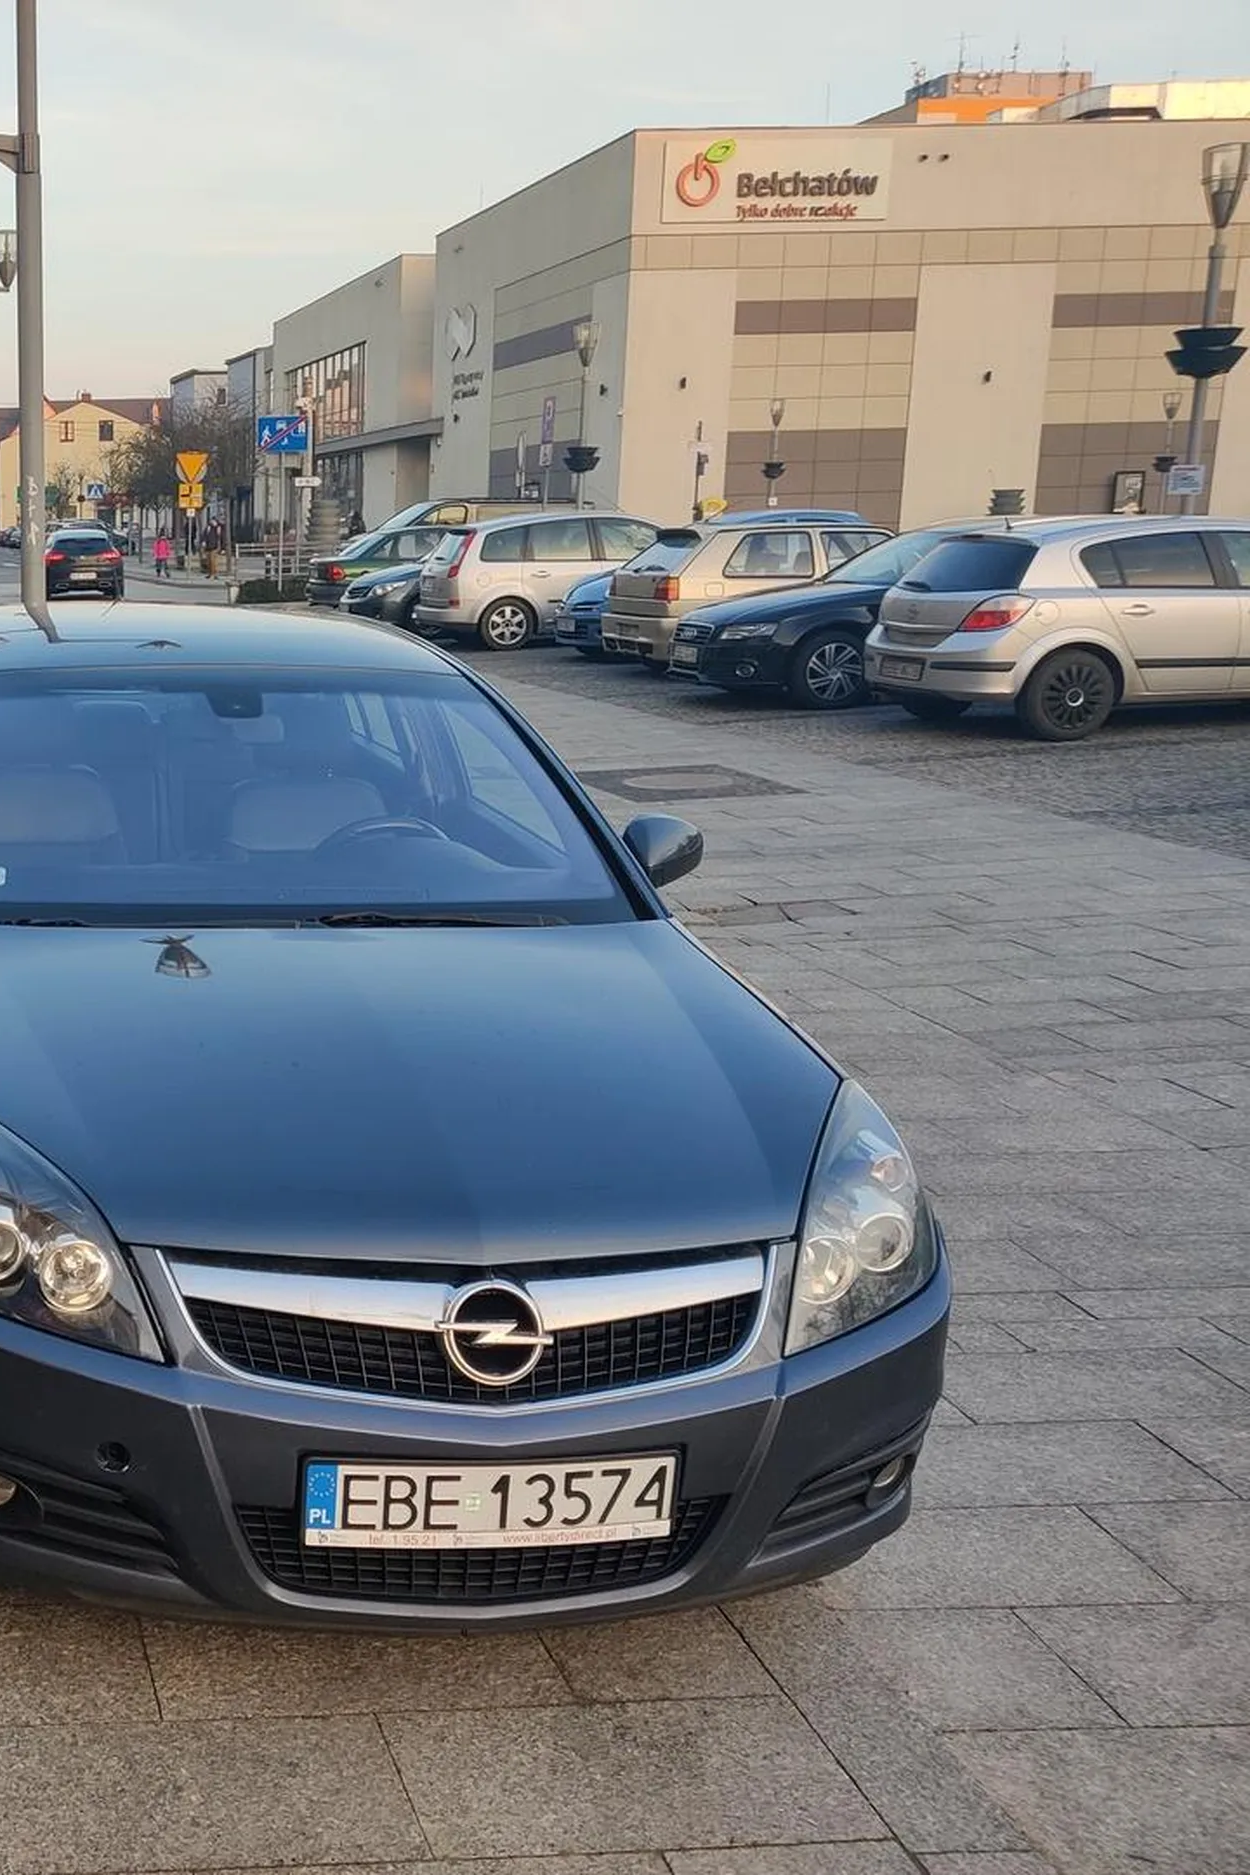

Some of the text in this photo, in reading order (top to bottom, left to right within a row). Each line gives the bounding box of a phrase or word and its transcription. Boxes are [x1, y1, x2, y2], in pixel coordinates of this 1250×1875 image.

[309, 1508, 332, 1525] PL
[341, 1464, 668, 1530] EBE 13574
